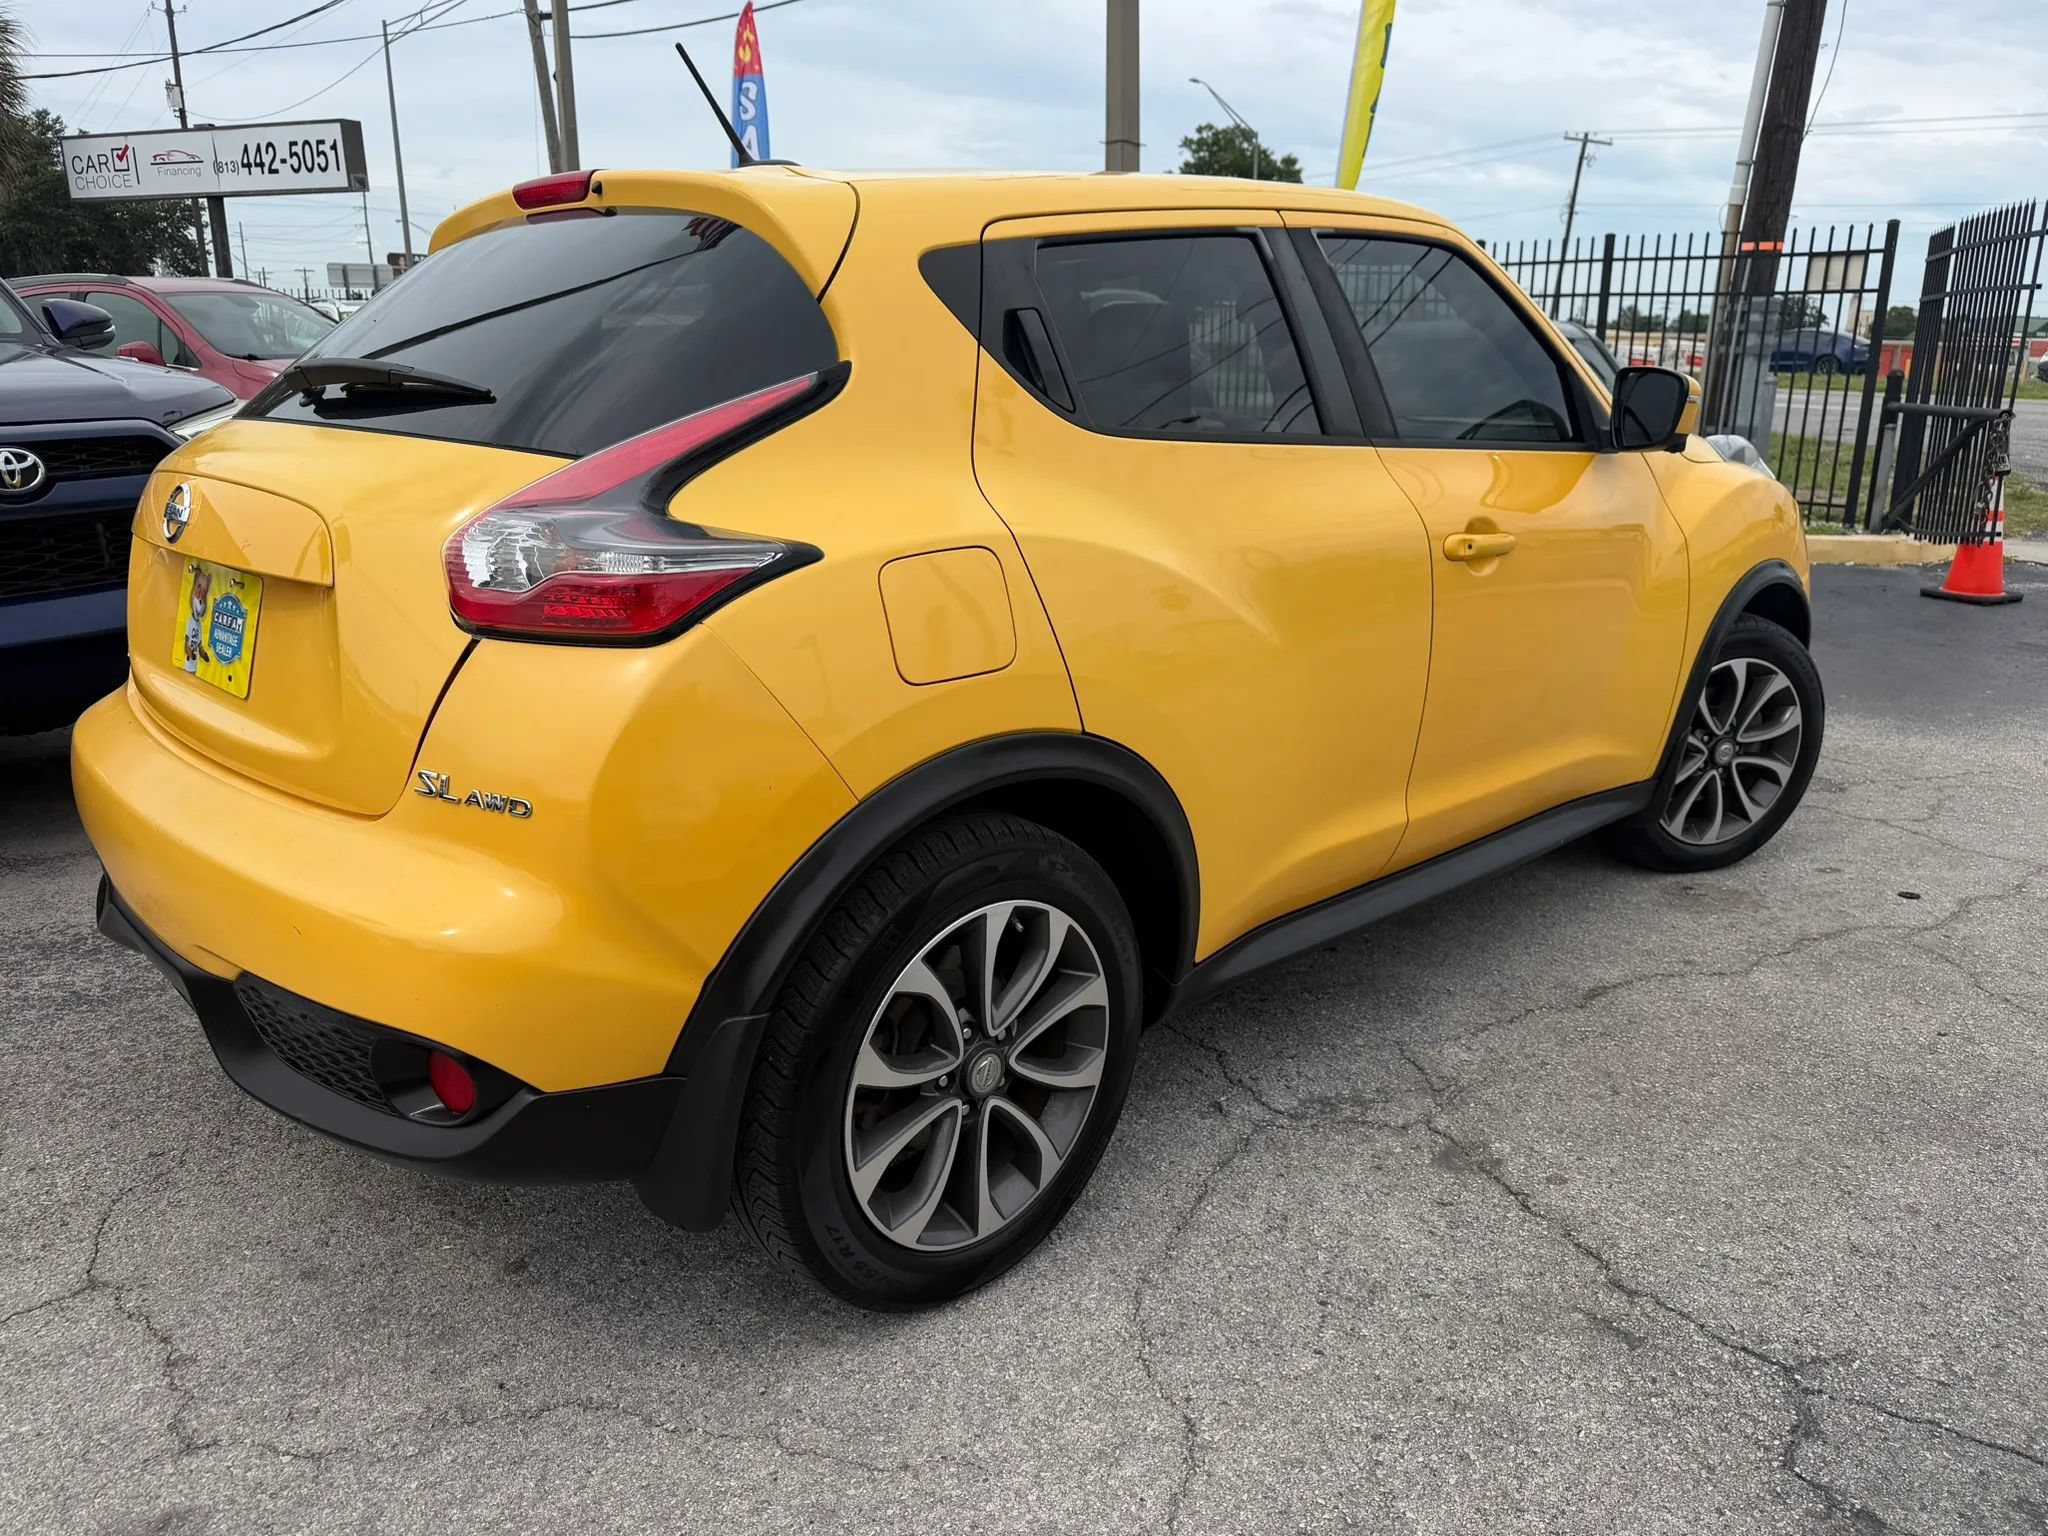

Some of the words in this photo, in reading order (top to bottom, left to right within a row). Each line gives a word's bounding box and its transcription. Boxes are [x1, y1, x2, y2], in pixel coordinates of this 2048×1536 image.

[71, 153, 111, 175] CAR
[212, 160, 240, 176] (813)
[241, 138, 340, 175] 442-5051
[75, 173, 133, 190] CHOICE
[157, 165, 202, 178] Financing
[214, 610, 244, 634] CARFAX
[213, 627, 239, 647] ADVANTAGE
[414, 768, 462, 805] SL
[463, 788, 534, 819] AWD
